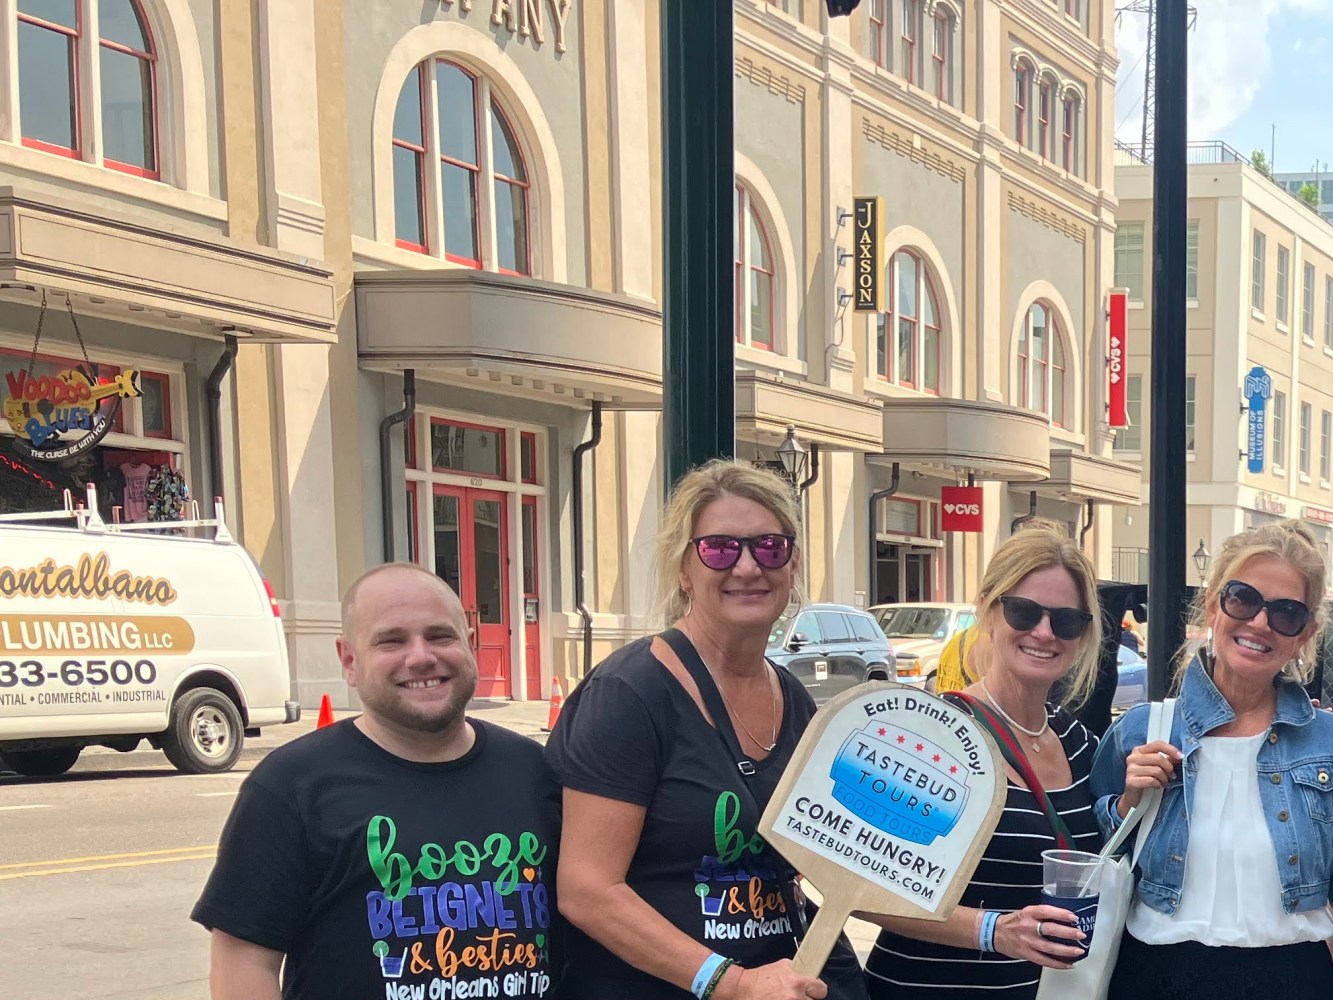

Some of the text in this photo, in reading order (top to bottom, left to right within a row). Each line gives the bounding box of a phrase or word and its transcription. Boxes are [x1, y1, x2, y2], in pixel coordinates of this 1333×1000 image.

[857, 201, 874, 302] JAXSON
[1110, 348, 1121, 373] CVS
[5, 369, 92, 406] VOODOO
[24, 406, 92, 447] BLUES
[29, 418, 107, 459] THE CURSE BE WITH YOU
[1248, 421, 1256, 460] MUSEUM
[1256, 410, 1264, 460] ILLUSIONS
[955, 503, 980, 515] CVS
[144, 632, 173, 649] LLC
[38, 690, 103, 705] COMMERCIAL
[112, 690, 166, 702] INDUSTRIAL
[863, 697, 986, 776] Eat! Drink! Enjoy!
[855, 741, 958, 803] TASTEBUD
[833, 784, 932, 844] FOOD TOURS
[366, 814, 548, 901] booze
[785, 815, 935, 900] TASTEBUDTOURS.COM
[795, 796, 853, 837] COME
[855, 827, 946, 884] HUNGRY!
[366, 880, 550, 940] BEIGNETS
[728, 886, 747, 914] &
[704, 919, 740, 940] New
[410, 926, 539, 978] & besties
[429, 975, 499, 1000] Orleans
[503, 970, 527, 997] Girl
